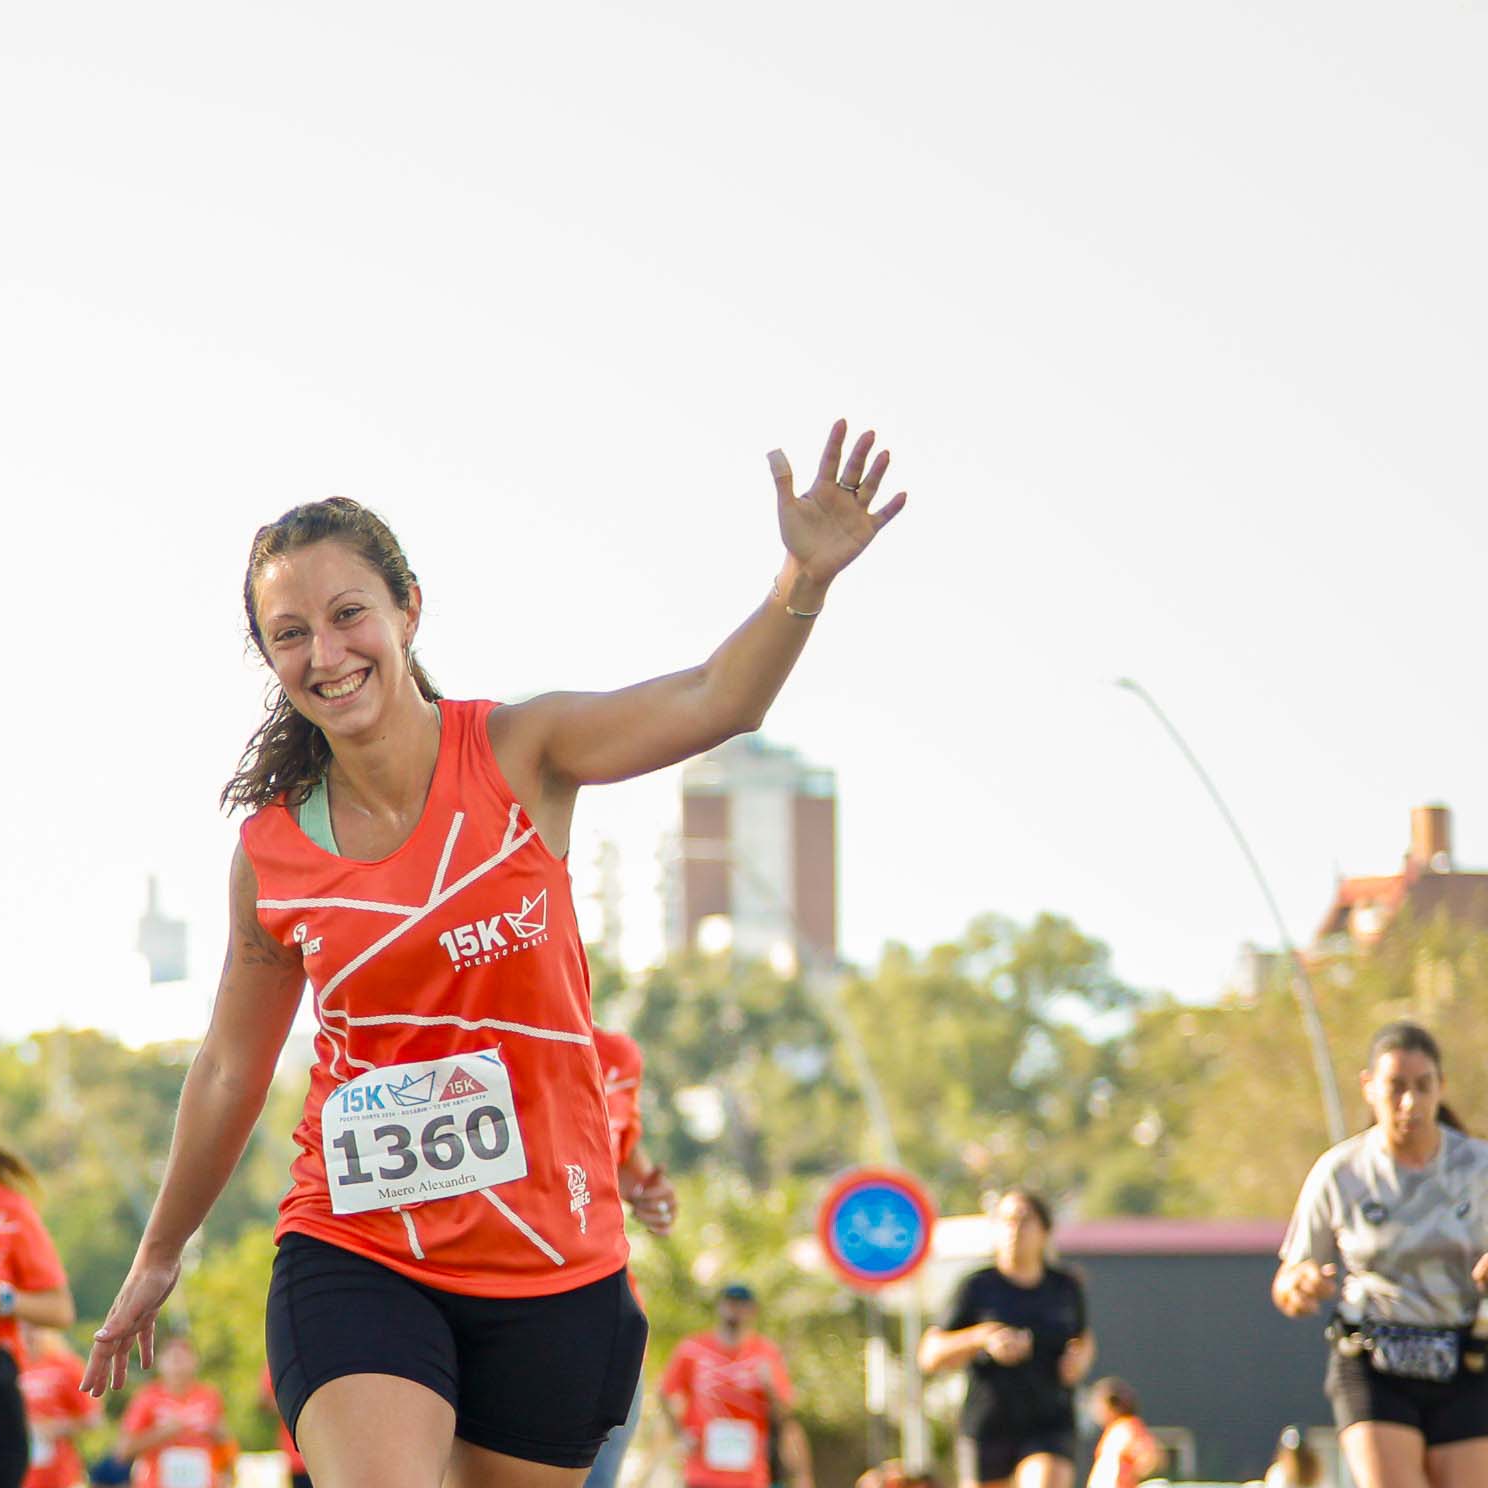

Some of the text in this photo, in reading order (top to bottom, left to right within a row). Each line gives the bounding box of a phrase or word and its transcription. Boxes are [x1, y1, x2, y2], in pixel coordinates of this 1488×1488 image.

[438, 914, 509, 962] 15K
[454, 949, 508, 973] PUERTO
[339, 1084, 385, 1113] 15K
[447, 1081, 476, 1095] 15K
[333, 1104, 510, 1186] 1360
[378, 1174, 477, 1200] Maero Alexandra
